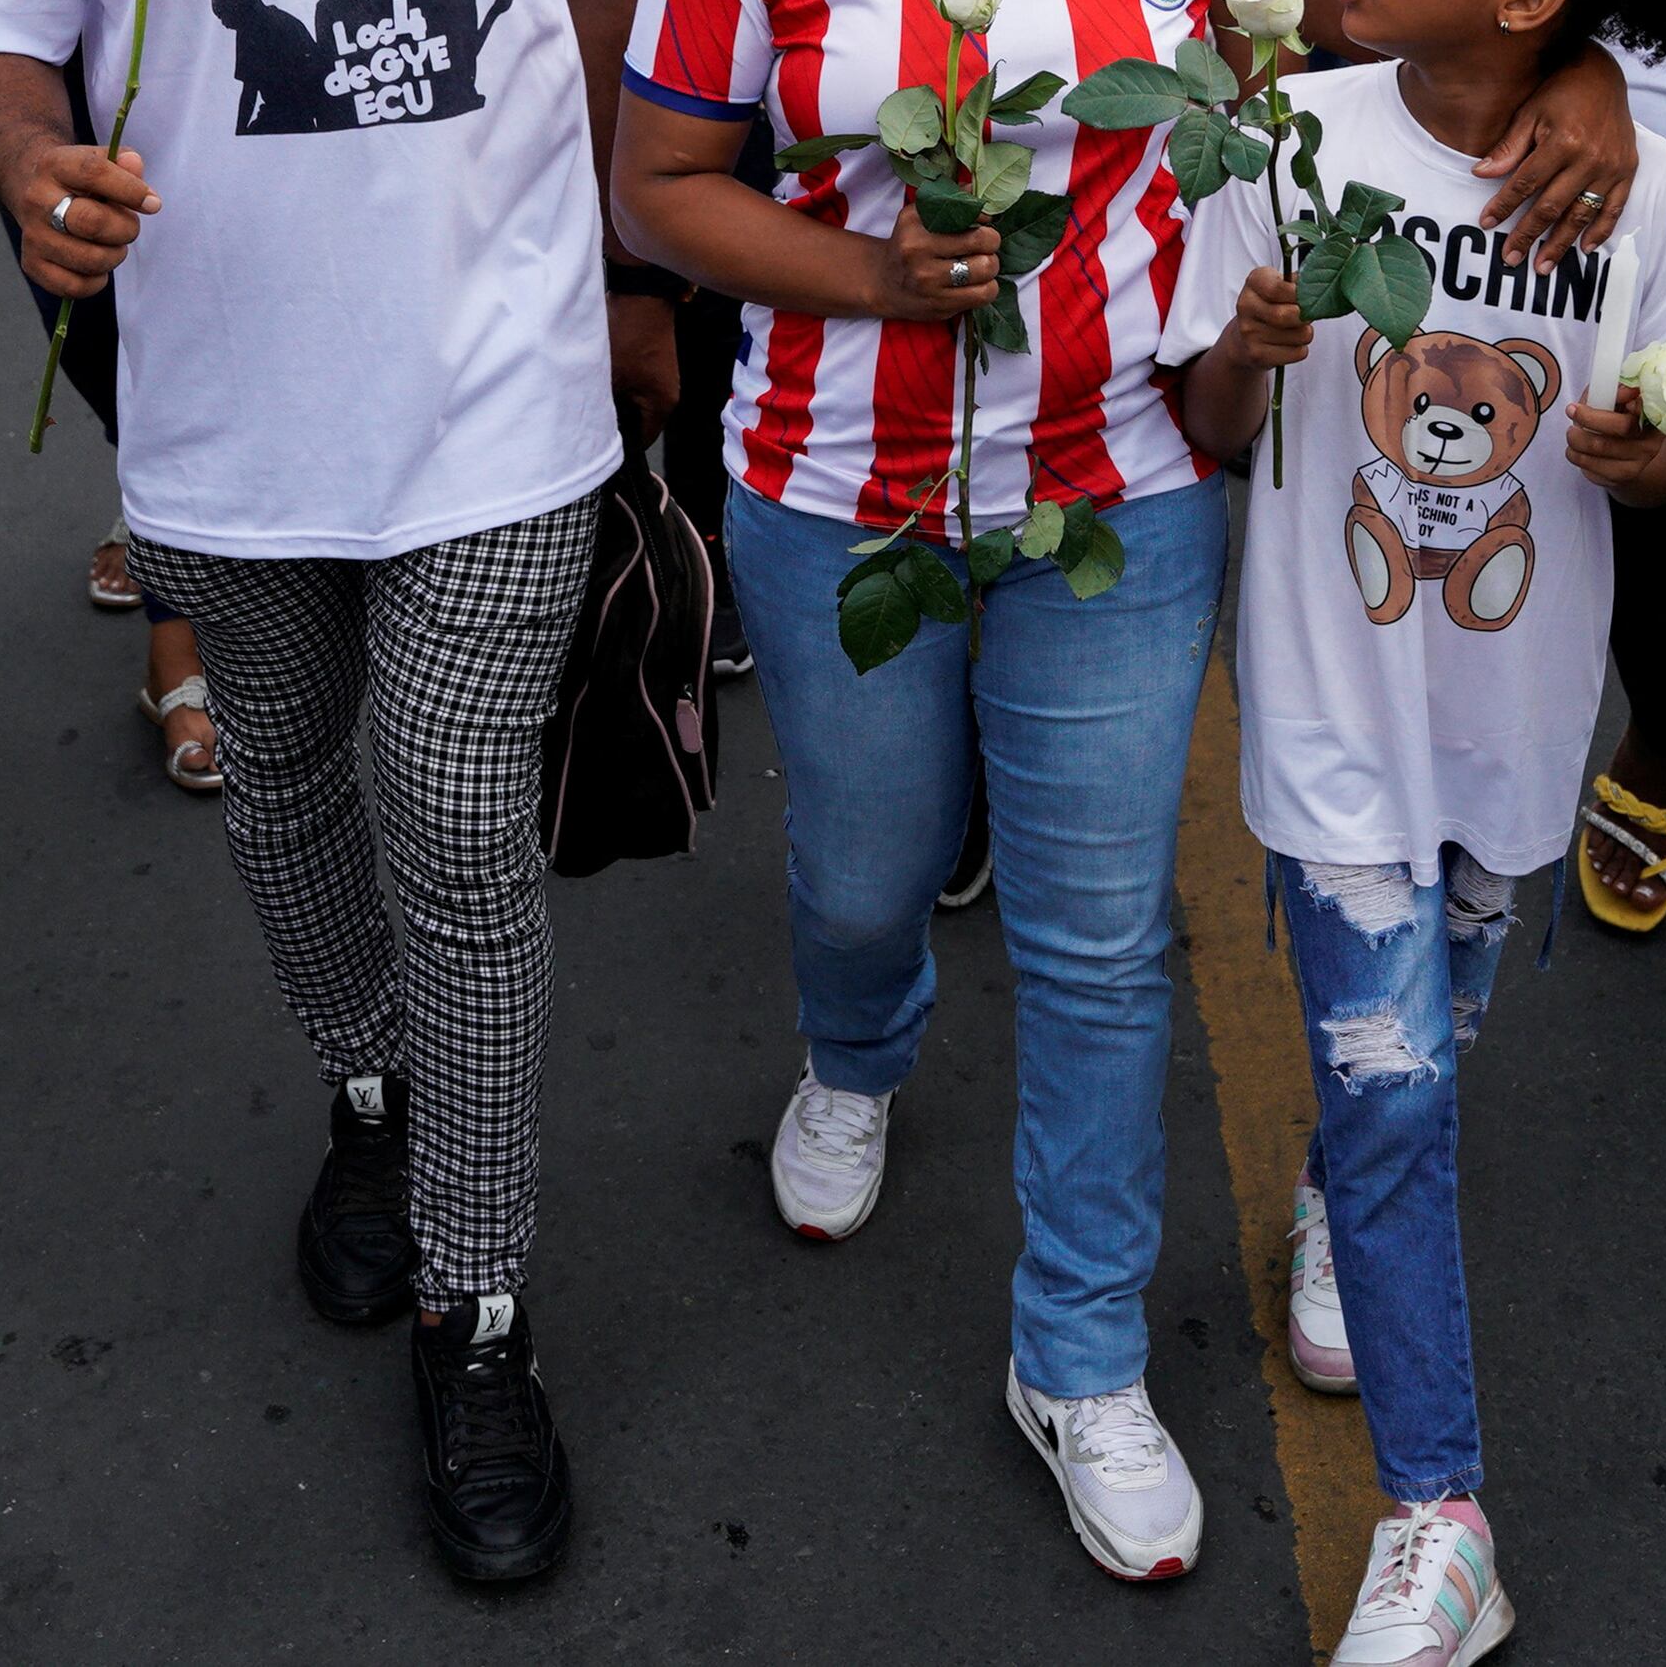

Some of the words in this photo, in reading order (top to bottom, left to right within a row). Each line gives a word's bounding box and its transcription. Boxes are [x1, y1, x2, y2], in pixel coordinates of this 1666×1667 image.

[353, 79, 434, 125] ECU
[1436, 492, 1460, 509] NOT
[1465, 499, 1474, 512] A
[1417, 523, 1435, 538] OY
